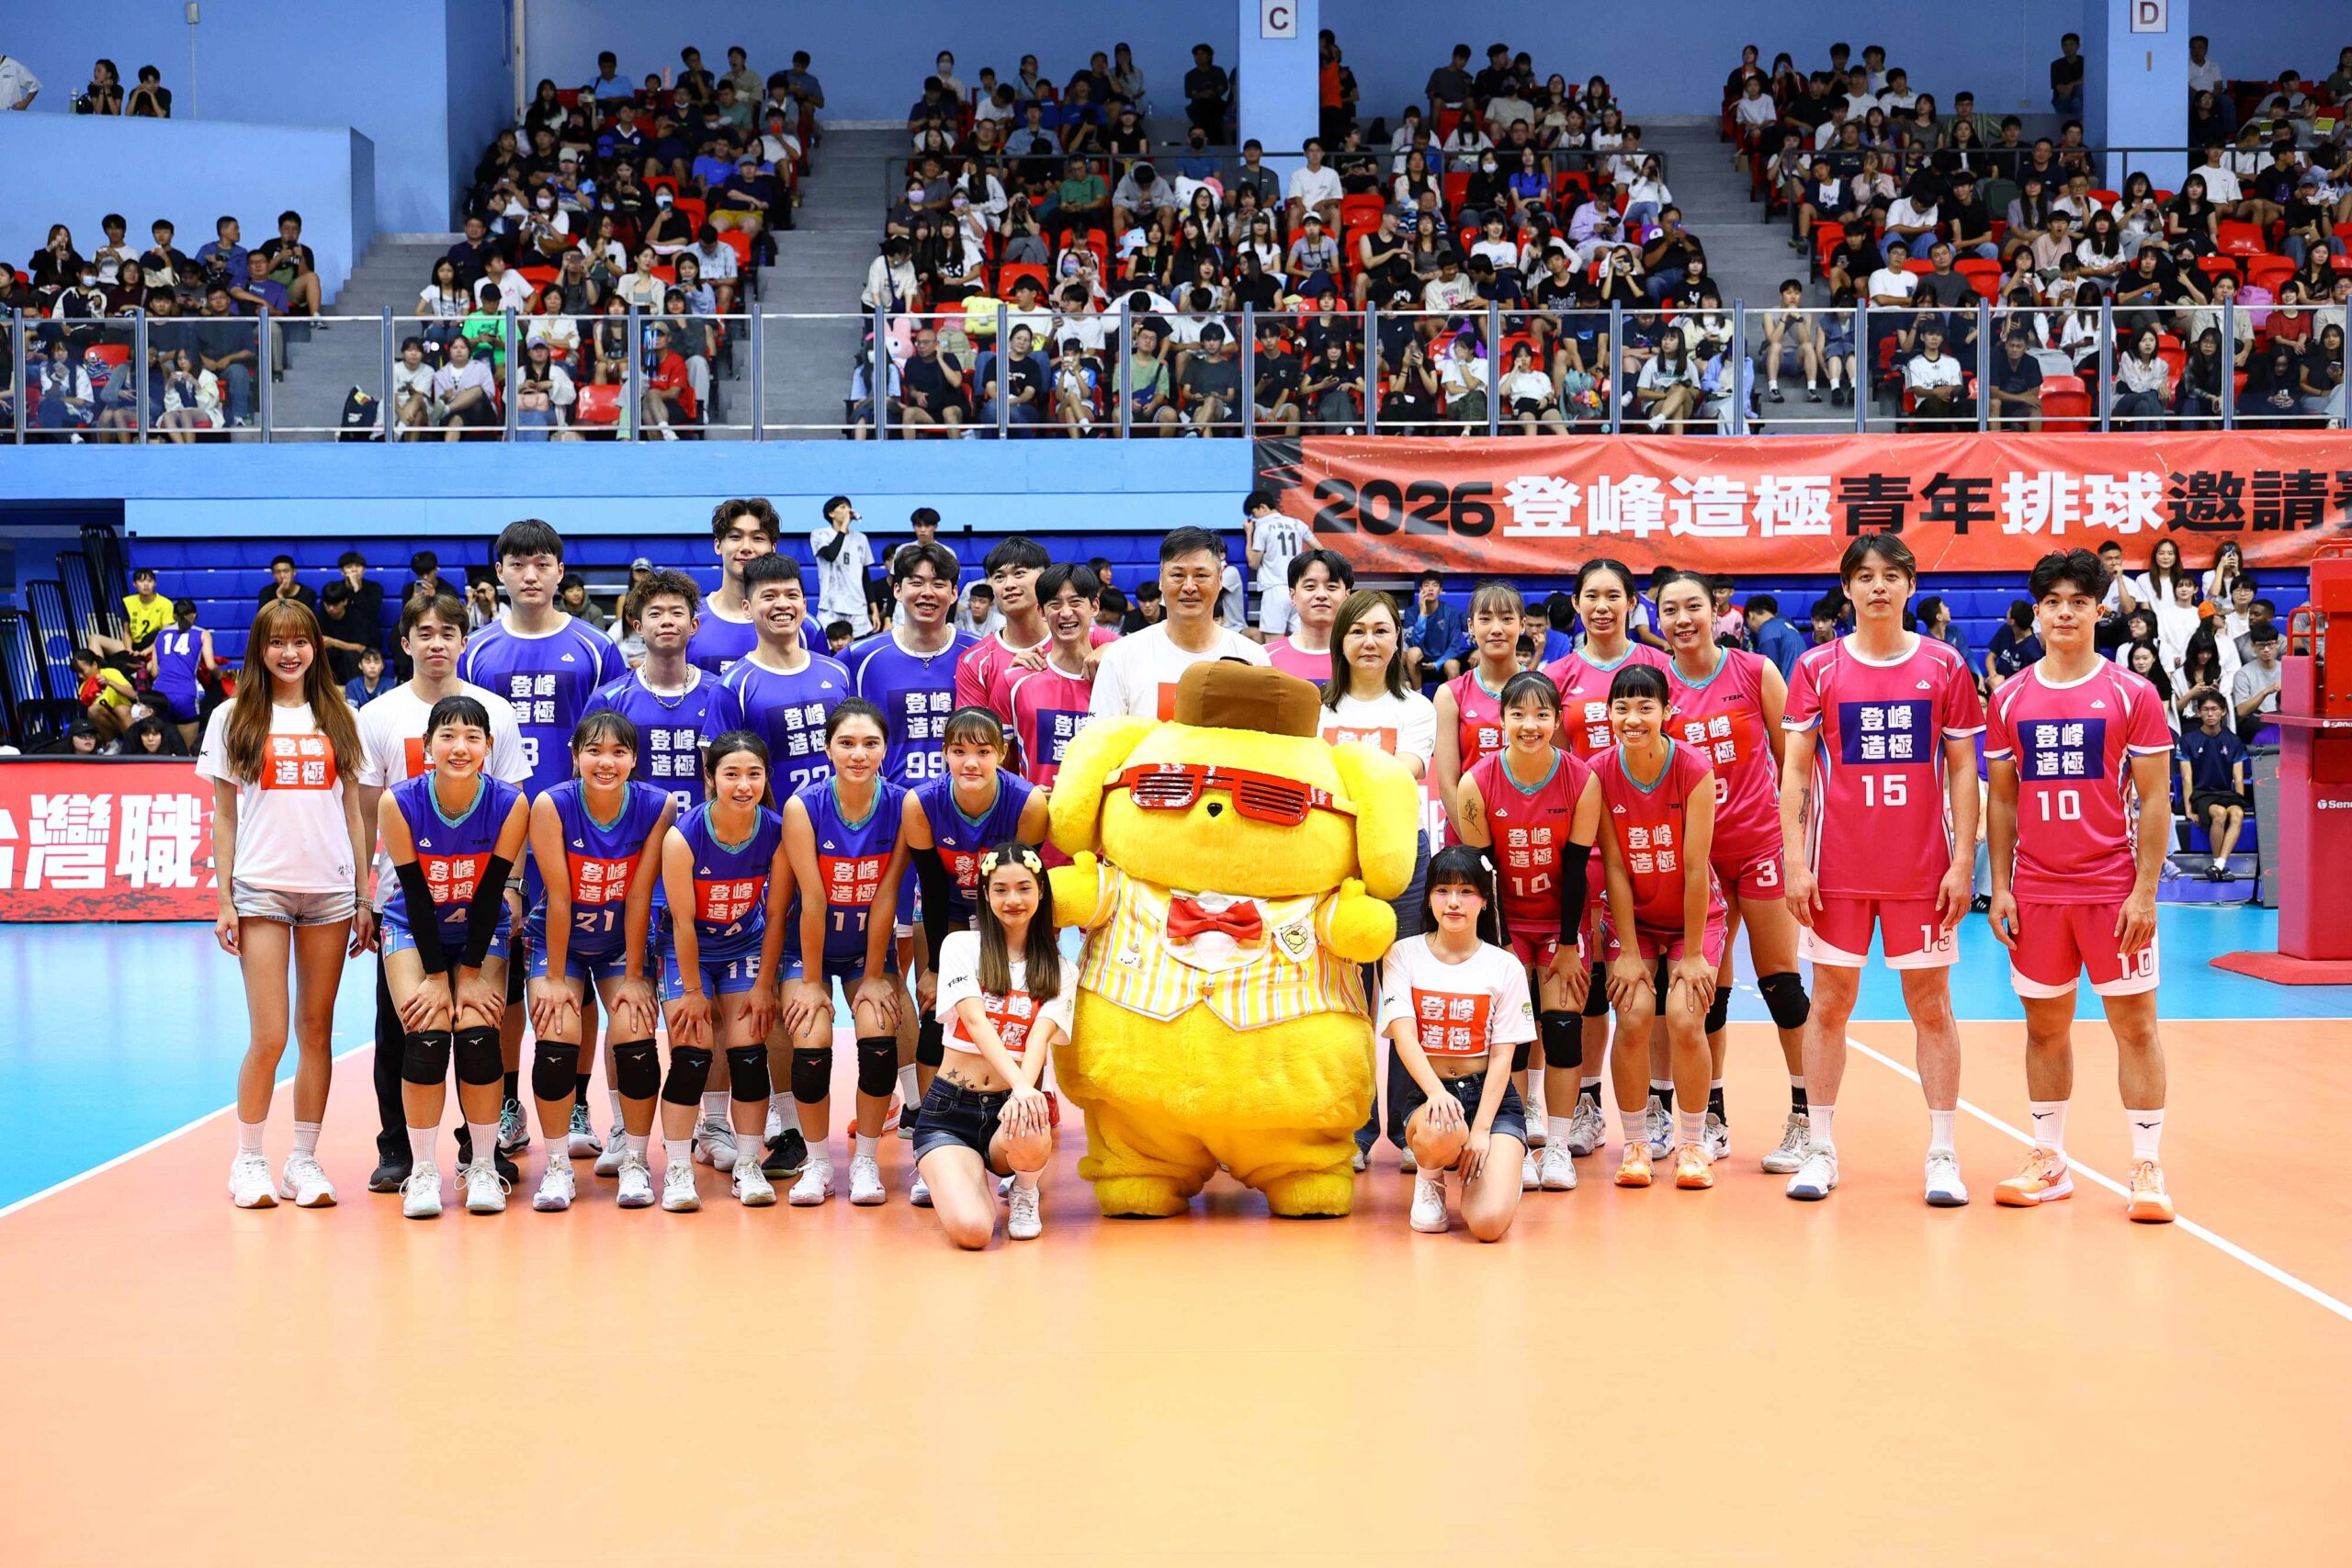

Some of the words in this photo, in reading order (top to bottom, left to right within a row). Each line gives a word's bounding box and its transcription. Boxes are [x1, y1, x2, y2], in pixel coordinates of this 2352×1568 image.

[1269, 6, 1289, 30] C
[2140, 2, 2159, 25] D
[1312, 468, 2352, 536] 2026登峰造極青年排球邀請
[1277, 531, 1297, 556] 11
[164, 632, 190, 655] 14
[510, 674, 556, 698] 登峰
[1721, 693, 1746, 703] TBK
[905, 692, 953, 715] 登峰
[783, 703, 827, 732] 登峰
[1860, 705, 1913, 731] 登峰
[650, 728, 697, 751] 登峰
[1477, 727, 1509, 749] 登
[1683, 715, 1735, 745] 登峰
[2035, 724, 2085, 749] 登峰
[272, 737, 325, 758] 登峰
[1860, 734, 1913, 761] 造極
[275, 761, 326, 786] 造極
[651, 754, 695, 777] 造極
[2035, 750, 2085, 776] 造極
[1860, 773, 1908, 807] 15
[2036, 789, 2082, 822] 10
[1508, 827, 1552, 849] 登峰
[1627, 823, 1673, 851] 登峰
[428, 858, 476, 883] 登峰
[1509, 849, 1553, 869] 造極
[1631, 849, 1679, 874] 造極
[580, 861, 628, 883] 登峰
[832, 860, 879, 883] 登峰
[1755, 863, 1779, 887] 3
[578, 880, 626, 904] 造極
[708, 882, 754, 903] 登峰
[831, 883, 878, 903] 造極
[1511, 872, 1552, 897] 10
[444, 908, 468, 923] 4
[573, 908, 616, 933] 21
[706, 900, 752, 921] 造極
[833, 910, 868, 932] 11
[1920, 923, 1953, 953] 15
[2117, 945, 2155, 981] 10
[946, 975, 969, 989] TBK
[1420, 995, 1476, 1022] 登峰
[1420, 1023, 1471, 1052] 造極
